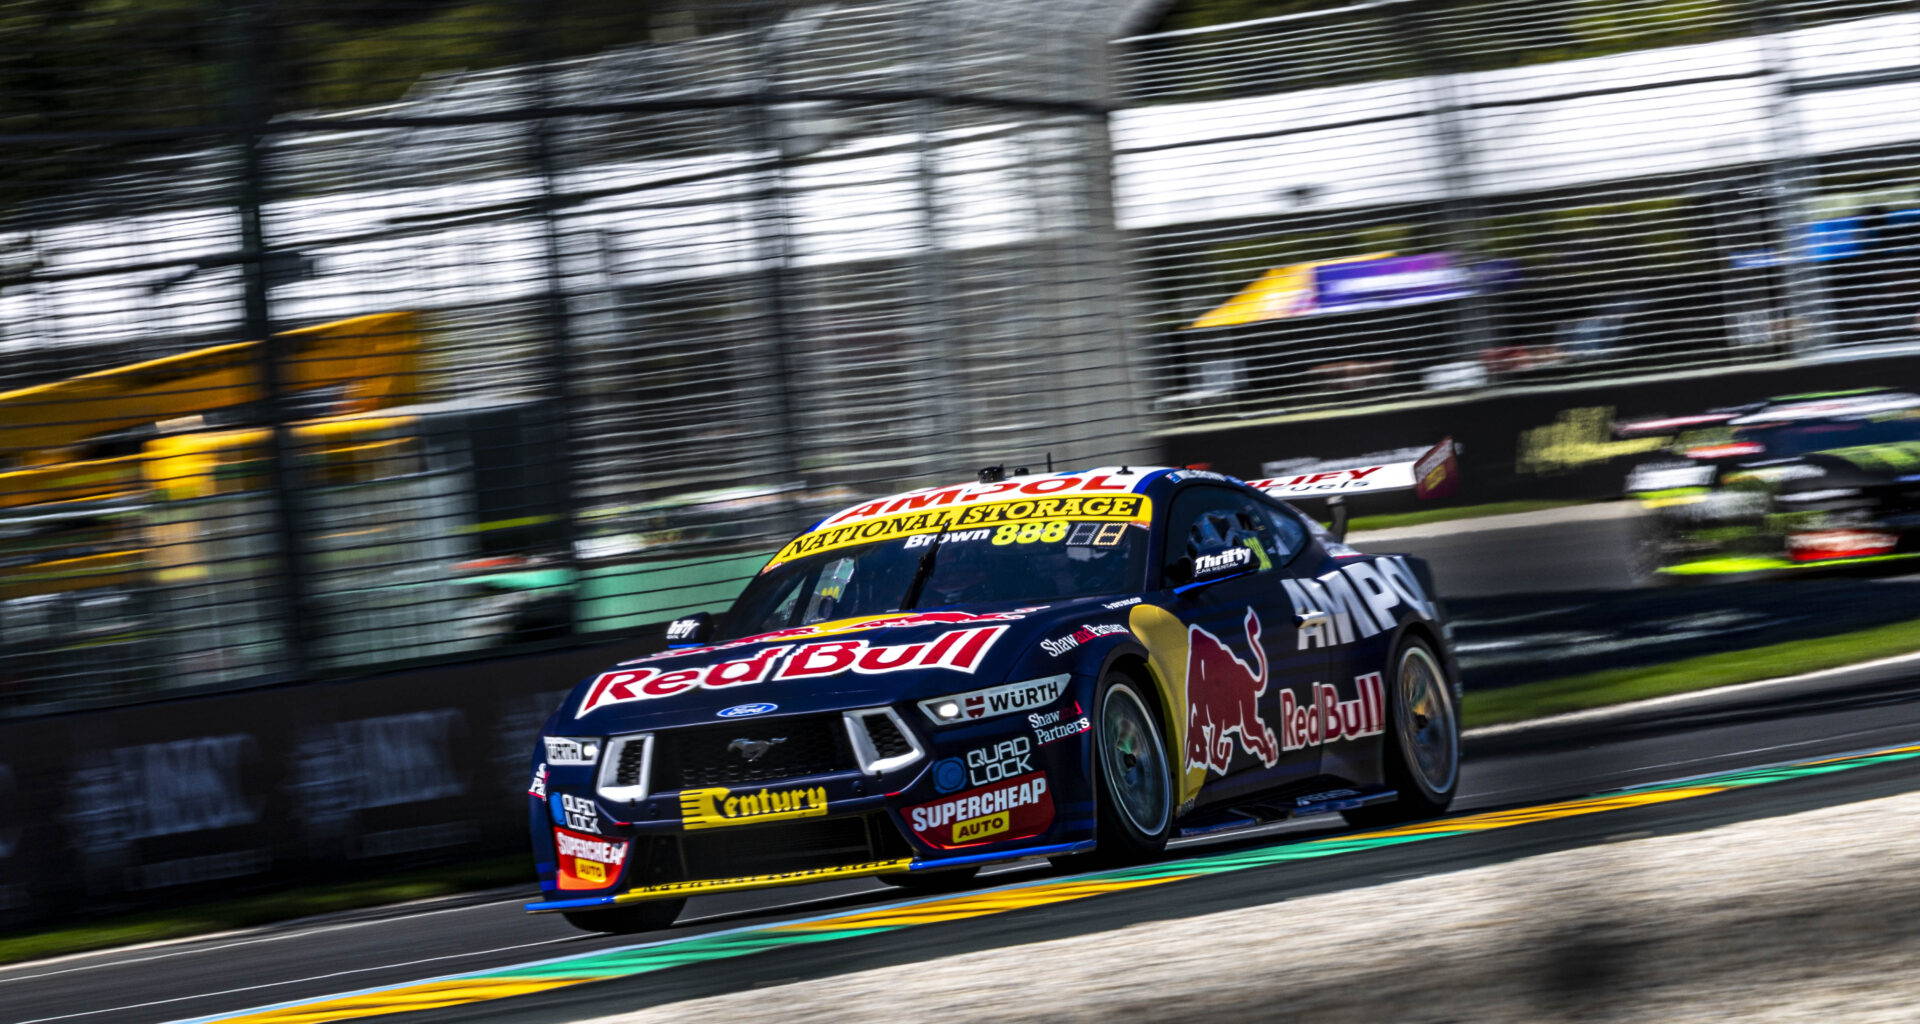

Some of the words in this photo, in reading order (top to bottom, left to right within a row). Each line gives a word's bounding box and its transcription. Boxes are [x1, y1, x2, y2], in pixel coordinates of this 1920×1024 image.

[829, 475, 1126, 525] AMPOL
[783, 510, 951, 558] NATIONAL
[963, 496, 1136, 524] STORAGE
[903, 529, 990, 549] Brown
[991, 520, 1069, 546] 888
[1195, 547, 1251, 571] Thrifty
[1040, 634, 1079, 657] Shaw
[574, 645, 798, 719] Red
[775, 624, 1011, 681] Bull
[989, 682, 1060, 712] WÜRTH
[1280, 682, 1320, 751] Red
[1320, 671, 1385, 741] Bull
[1028, 711, 1060, 728] Shaw
[1034, 717, 1090, 745] Partners
[967, 737, 1030, 768] QUAD
[970, 754, 1034, 786] LOCK
[680, 786, 828, 830] Century
[911, 777, 1047, 832] SUPERCHEAP
[566, 812, 601, 834] LOCK
[958, 817, 1004, 838] AUTO
[557, 832, 628, 866] SUPERCHEAP
[579, 863, 602, 878] AUTO
